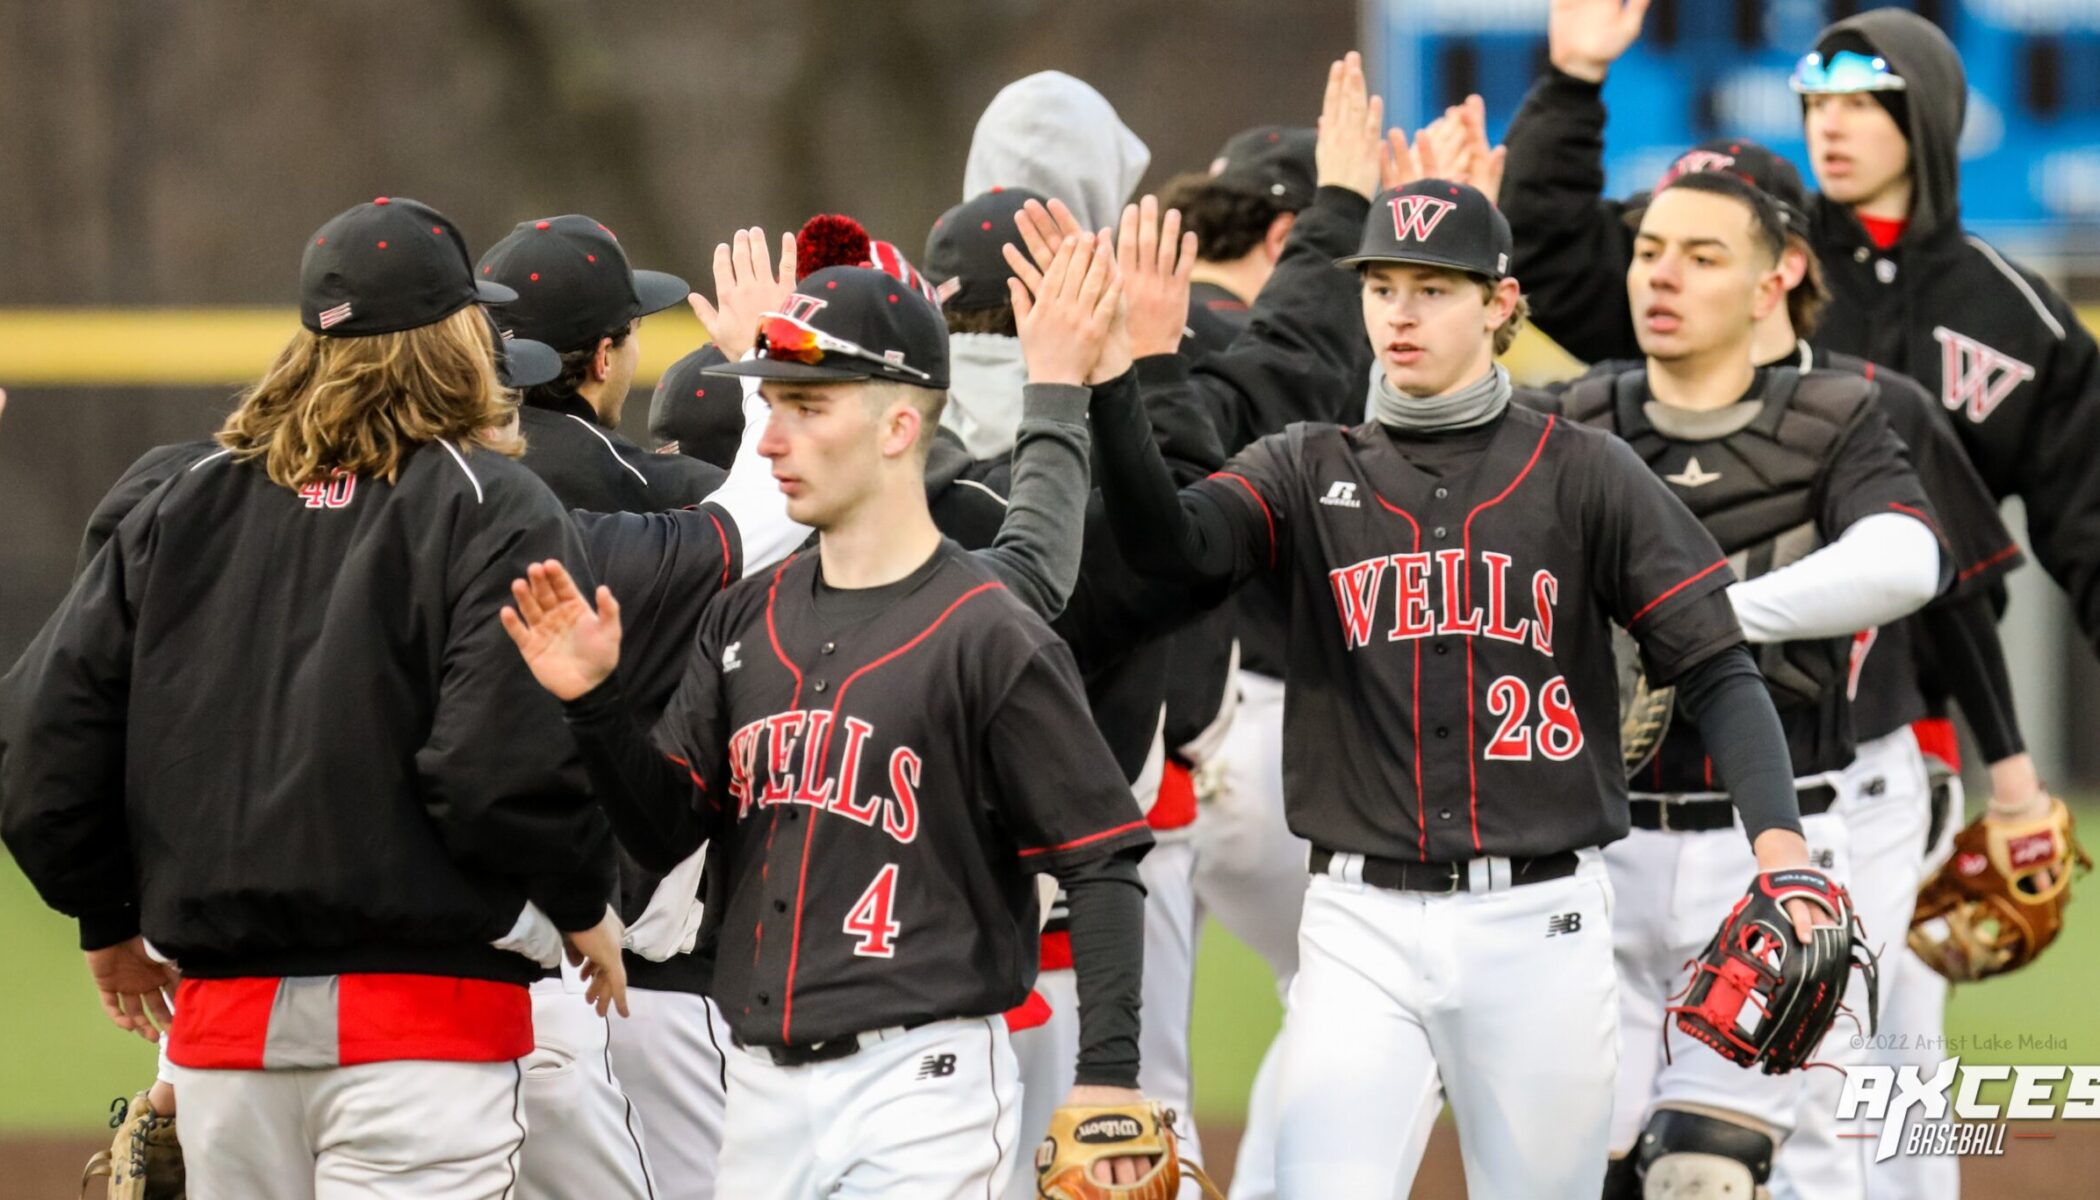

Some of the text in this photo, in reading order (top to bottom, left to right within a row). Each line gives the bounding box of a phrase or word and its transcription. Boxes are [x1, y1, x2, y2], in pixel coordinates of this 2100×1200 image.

[1387, 194, 1457, 242] W
[1932, 325, 2036, 424] W
[297, 466, 357, 509] 40
[1328, 547, 1558, 658] WELLS
[1483, 674, 1585, 762] 28
[842, 862, 900, 958] 4
[1078, 1119, 1139, 1138] Wilson
